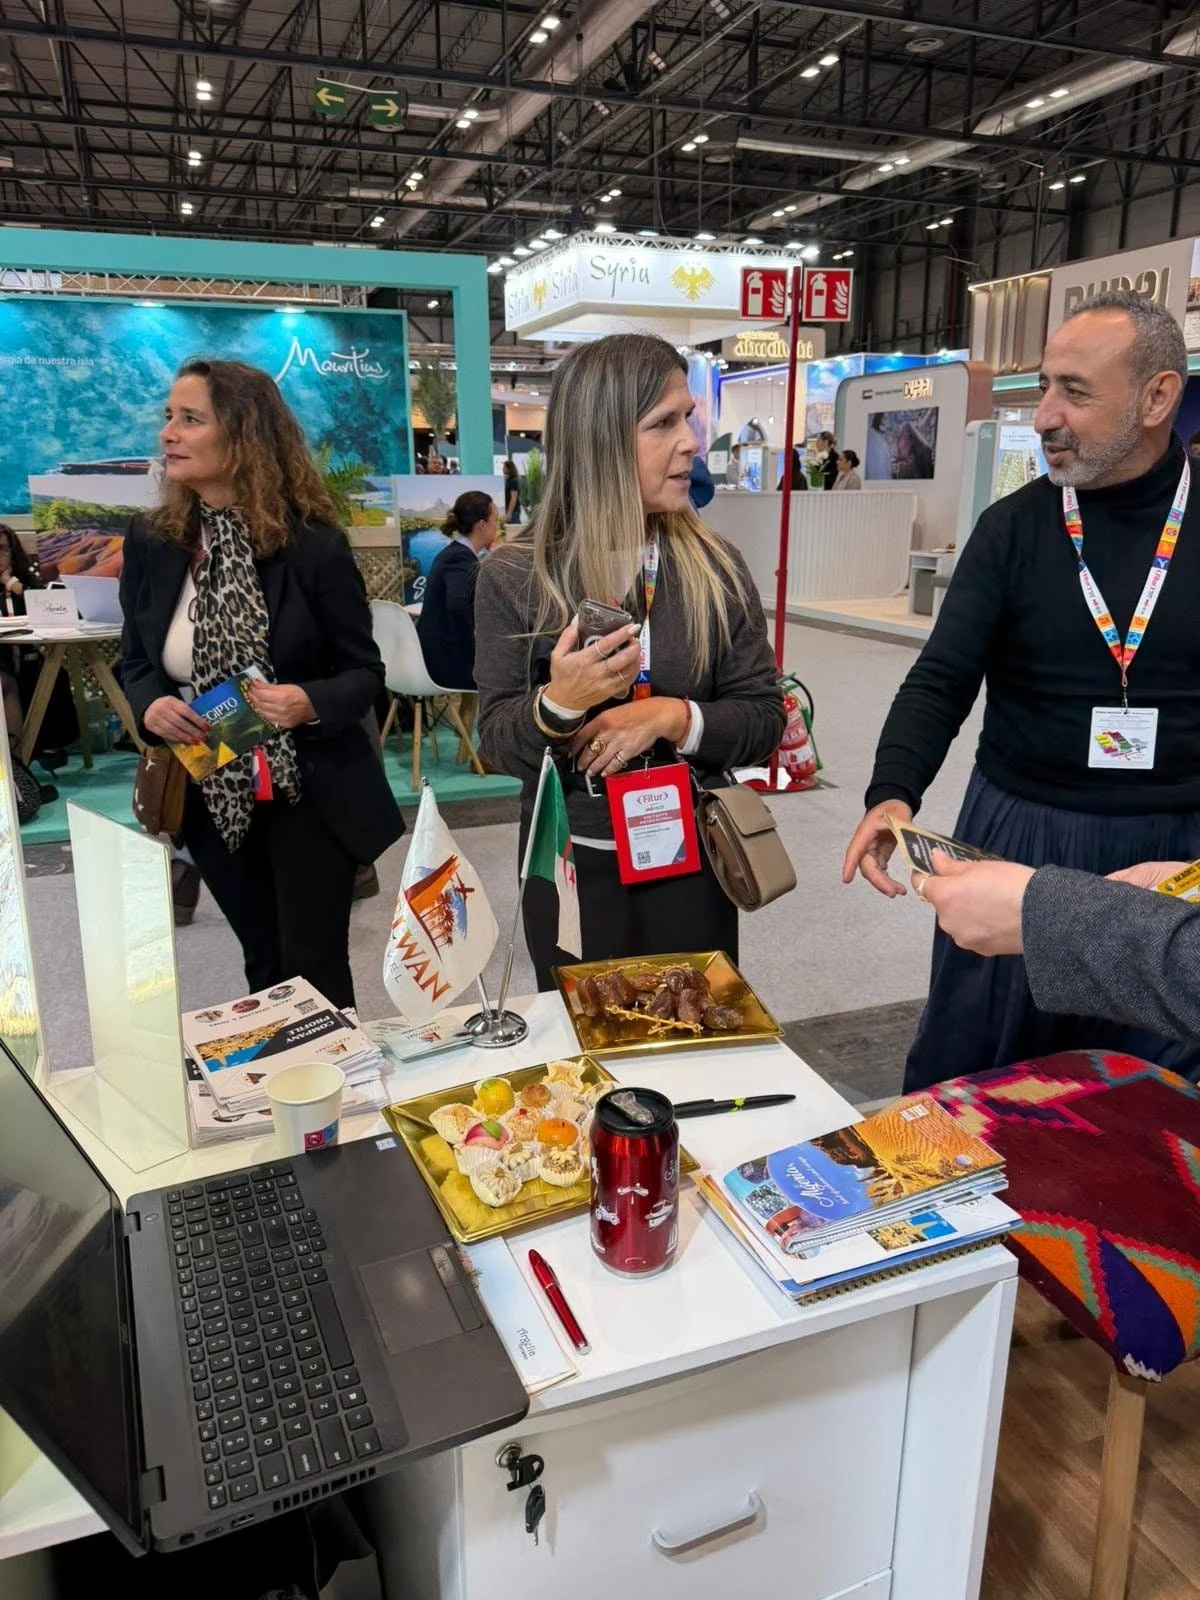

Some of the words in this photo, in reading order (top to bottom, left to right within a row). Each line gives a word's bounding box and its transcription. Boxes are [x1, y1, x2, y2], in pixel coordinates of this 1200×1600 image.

[590, 254, 650, 297] Syria
[275, 335, 391, 382] Mauritius
[642, 793, 664, 804] Fitur
[286, 1020, 335, 1043] COMPANY
[288, 1015, 331, 1036] PROFILE
